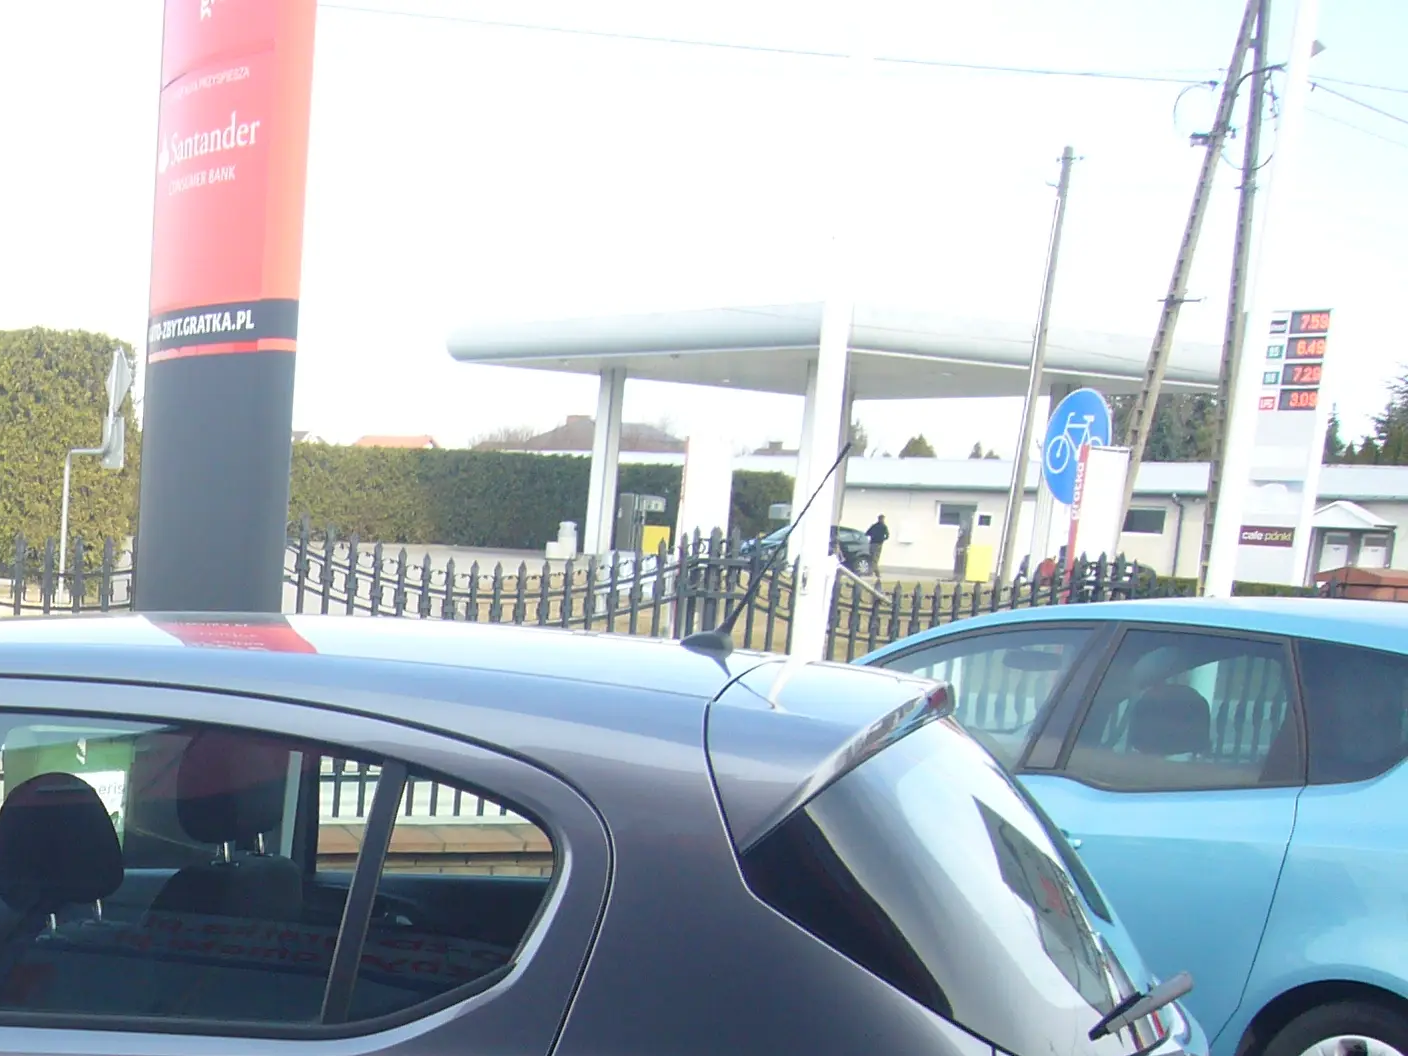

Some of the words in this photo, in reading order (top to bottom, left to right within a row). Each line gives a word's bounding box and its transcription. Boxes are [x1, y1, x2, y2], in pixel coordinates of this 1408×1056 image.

[170, 109, 260, 166] Santander
[208, 163, 237, 184] BANK
[1289, 392, 1318, 408] 3.09
